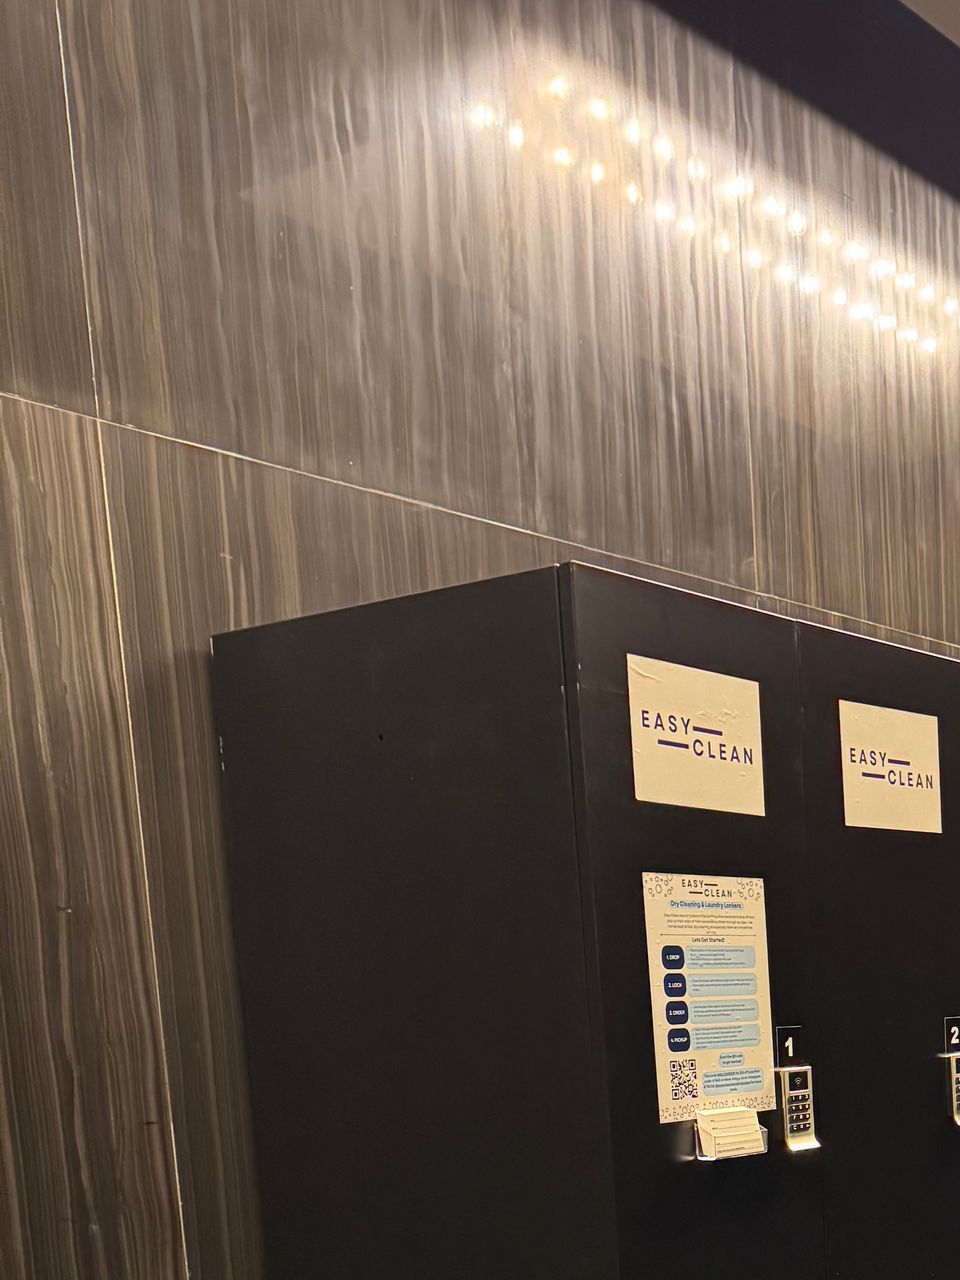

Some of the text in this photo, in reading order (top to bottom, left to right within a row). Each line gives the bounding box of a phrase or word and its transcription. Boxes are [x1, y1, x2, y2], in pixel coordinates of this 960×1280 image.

[641, 709, 691, 735] EASY
[692, 739, 753, 765] CLEAN
[850, 747, 886, 767] EASY
[887, 769, 933, 789] CLEAN
[681, 879, 704, 889] EASY
[704, 889, 733, 898] CLEAN
[680, 901, 700, 909] Cleaning
[950, 1026, 960, 1044] 2
[784, 1036, 794, 1057] 1
